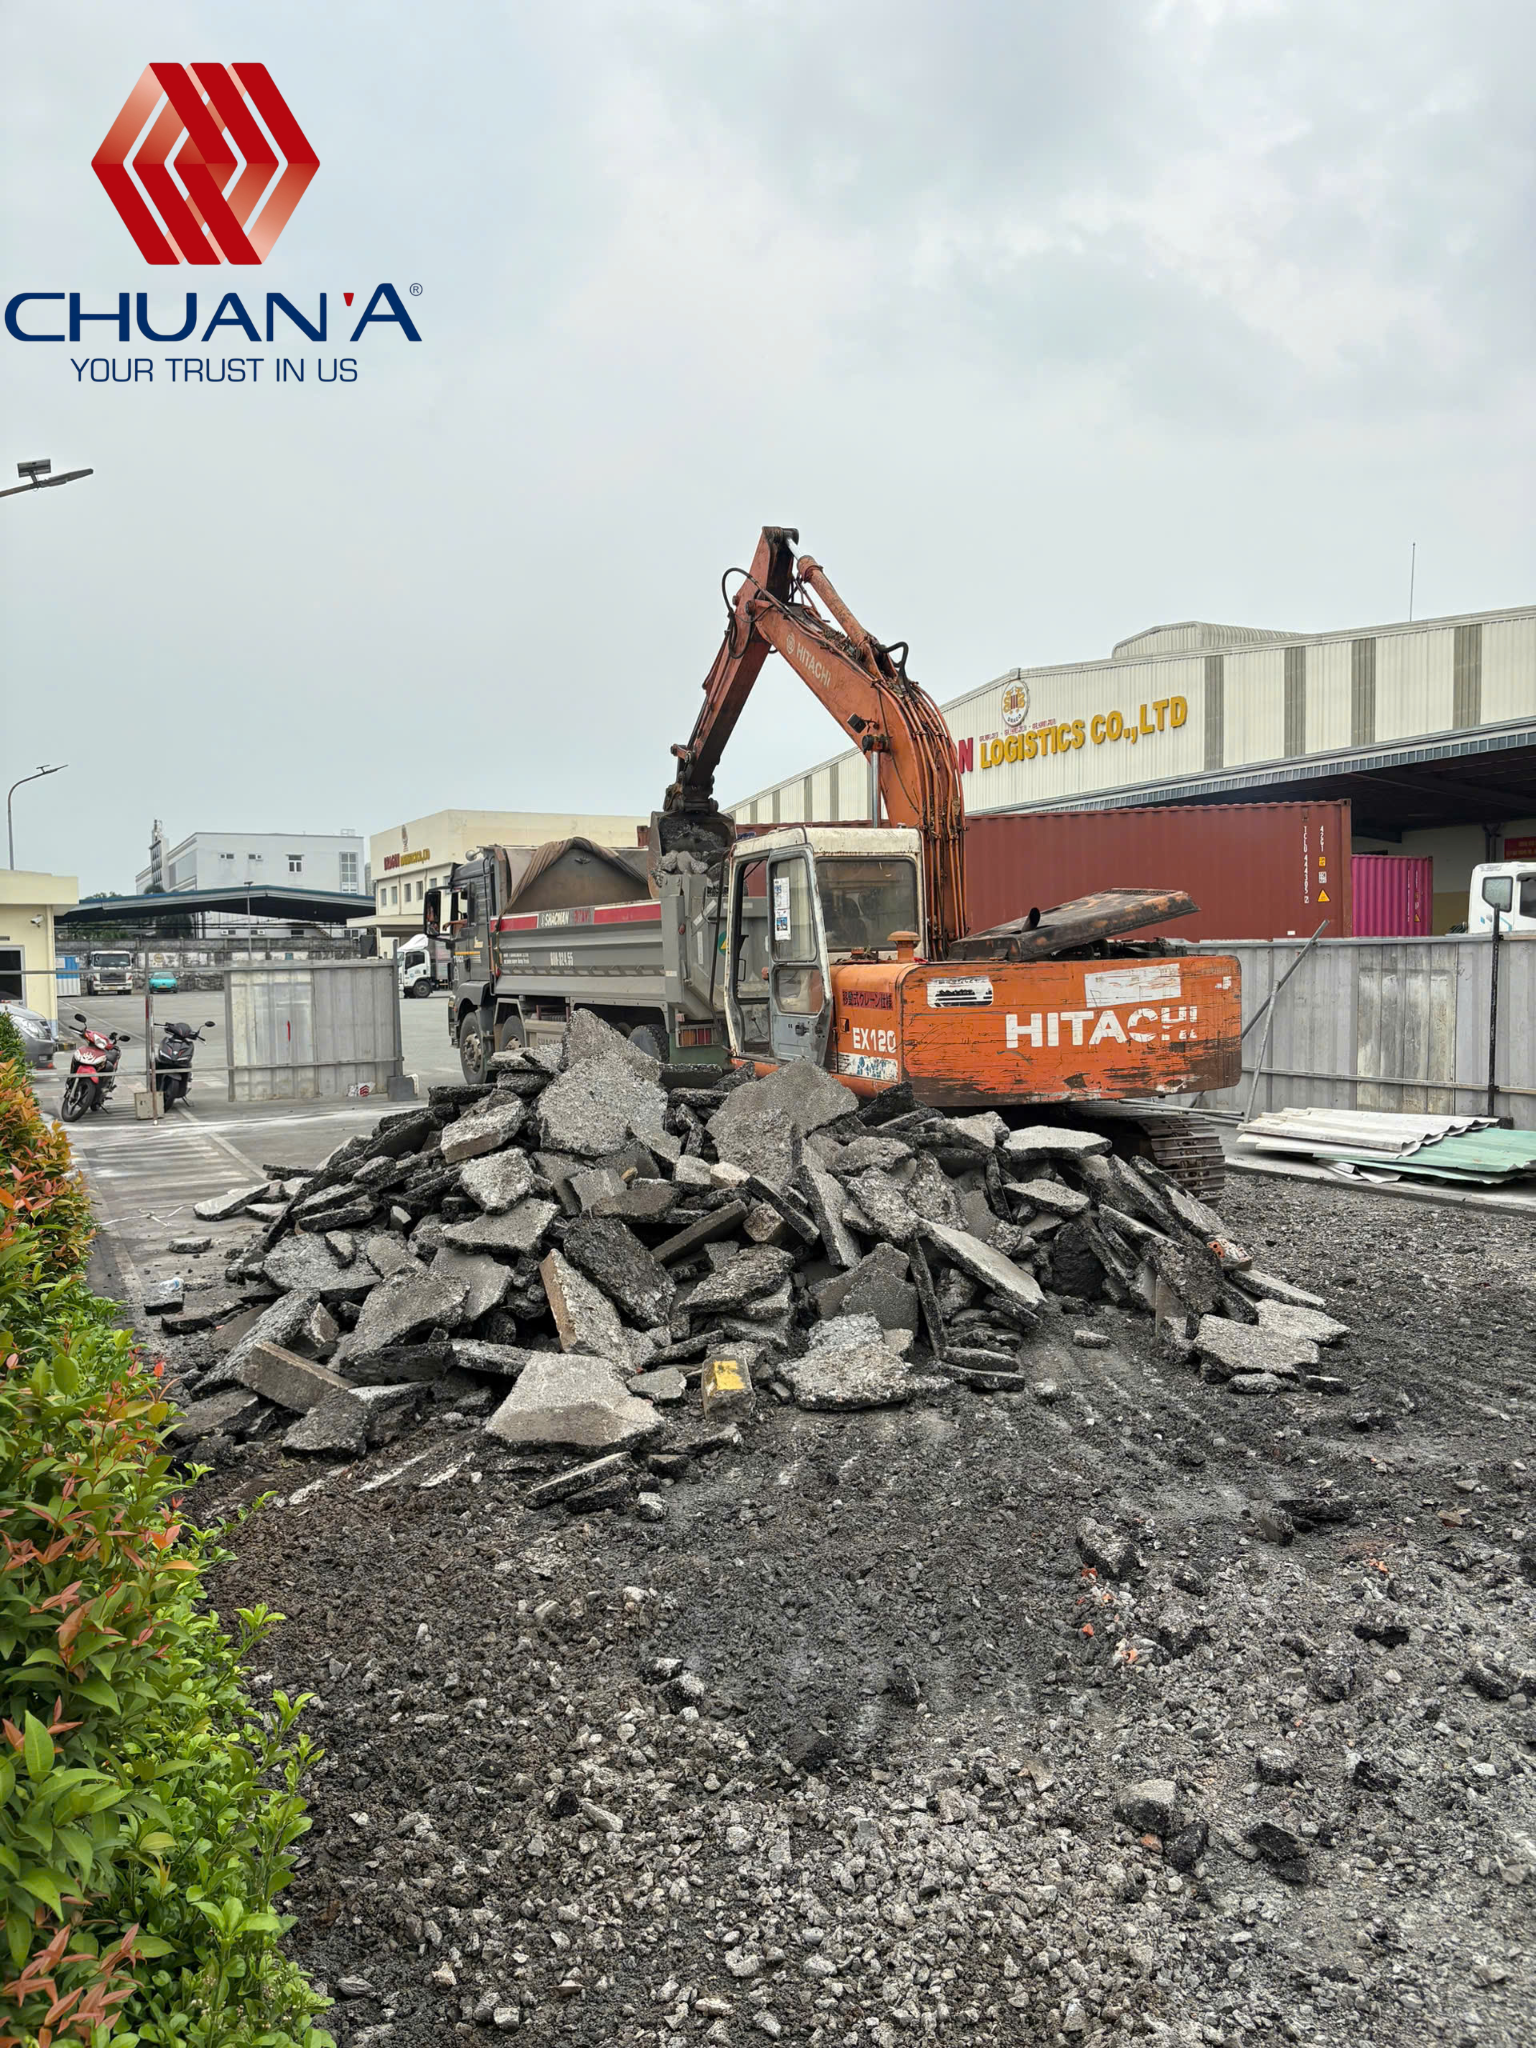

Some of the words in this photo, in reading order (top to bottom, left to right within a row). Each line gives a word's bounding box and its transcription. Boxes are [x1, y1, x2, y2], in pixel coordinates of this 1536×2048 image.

[797, 643, 831, 686] HITACHI
[980, 719, 1085, 769] LOGISTICS
[852, 1027, 897, 1054] EX120
[1004, 1005, 1199, 1049] HITACHI
